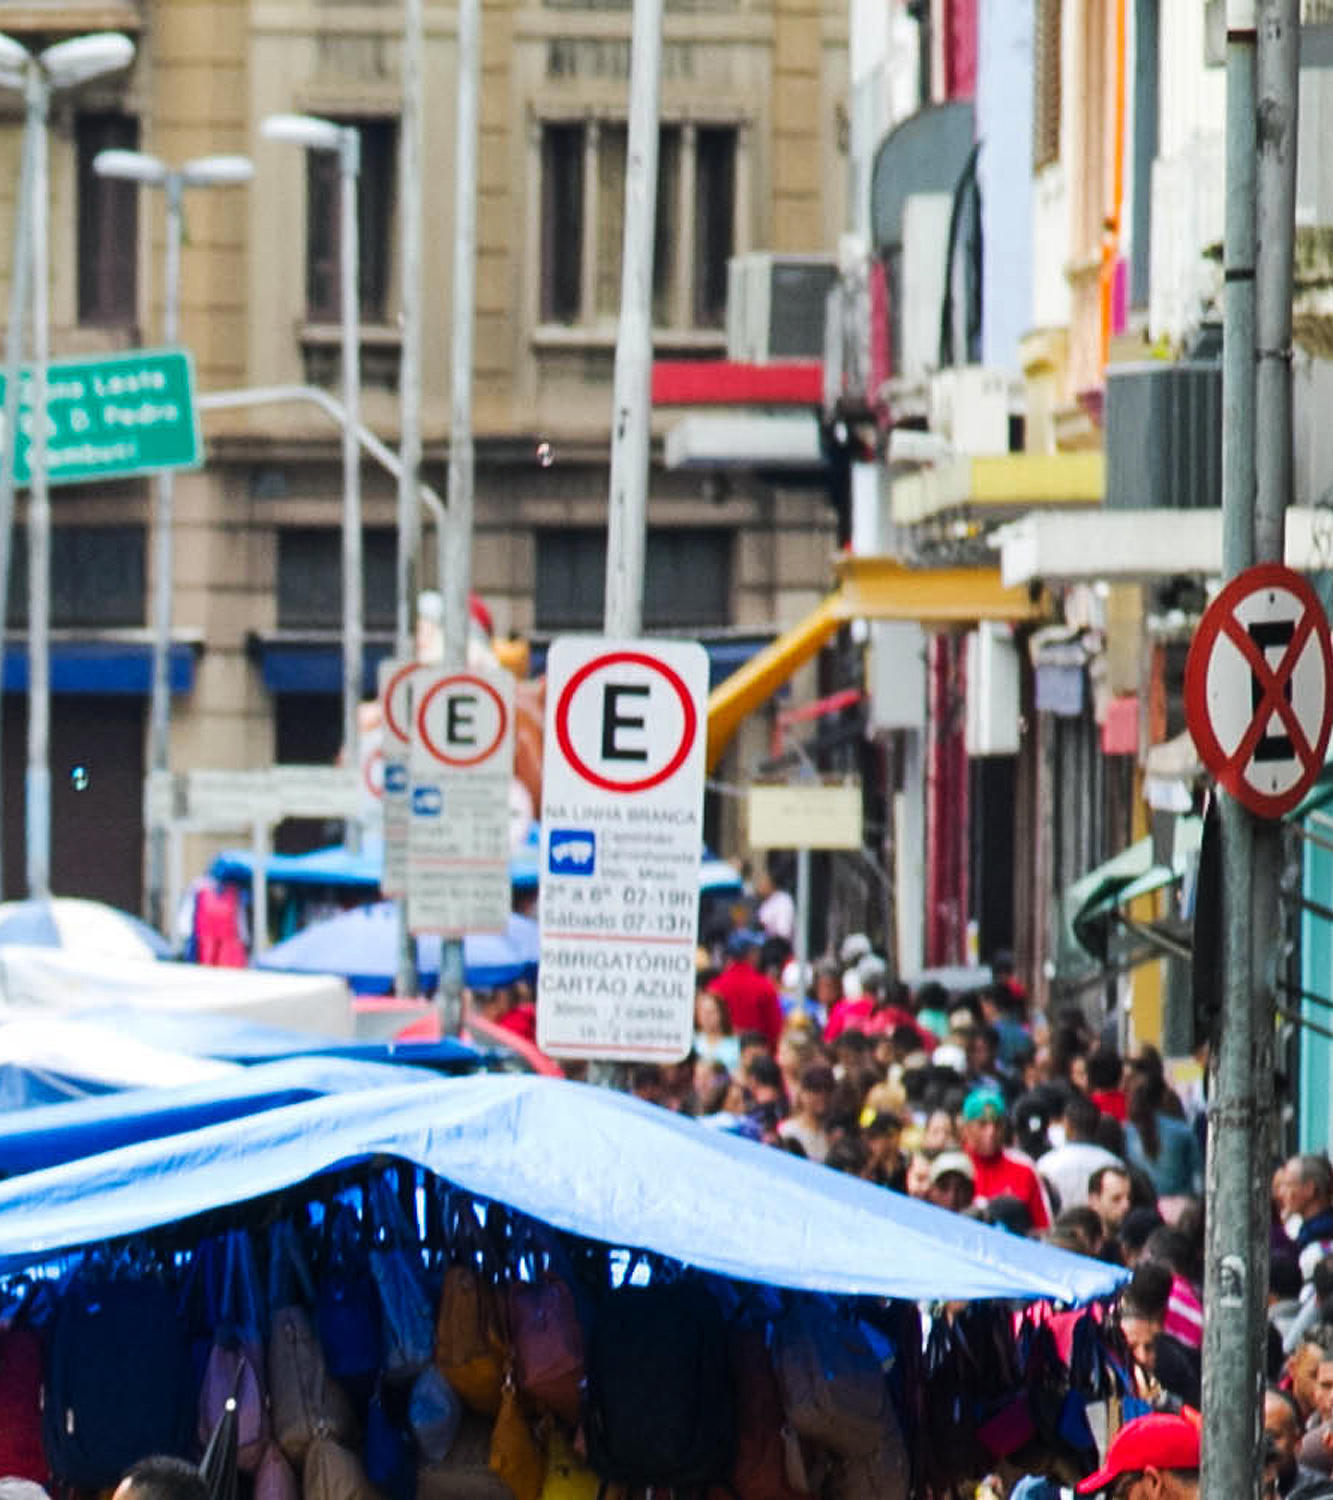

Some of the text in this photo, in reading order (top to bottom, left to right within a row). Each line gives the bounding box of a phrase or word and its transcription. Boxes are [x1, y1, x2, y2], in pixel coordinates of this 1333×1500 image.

[446, 695, 479, 745] E
[600, 682, 652, 763] E
[545, 804, 696, 825] NA LINHA BRANCA
[544, 909, 616, 930] Sábado
[542, 948, 691, 974] OBRIGATÓRIO
[541, 973, 687, 1000] CARTÃO AZUL
